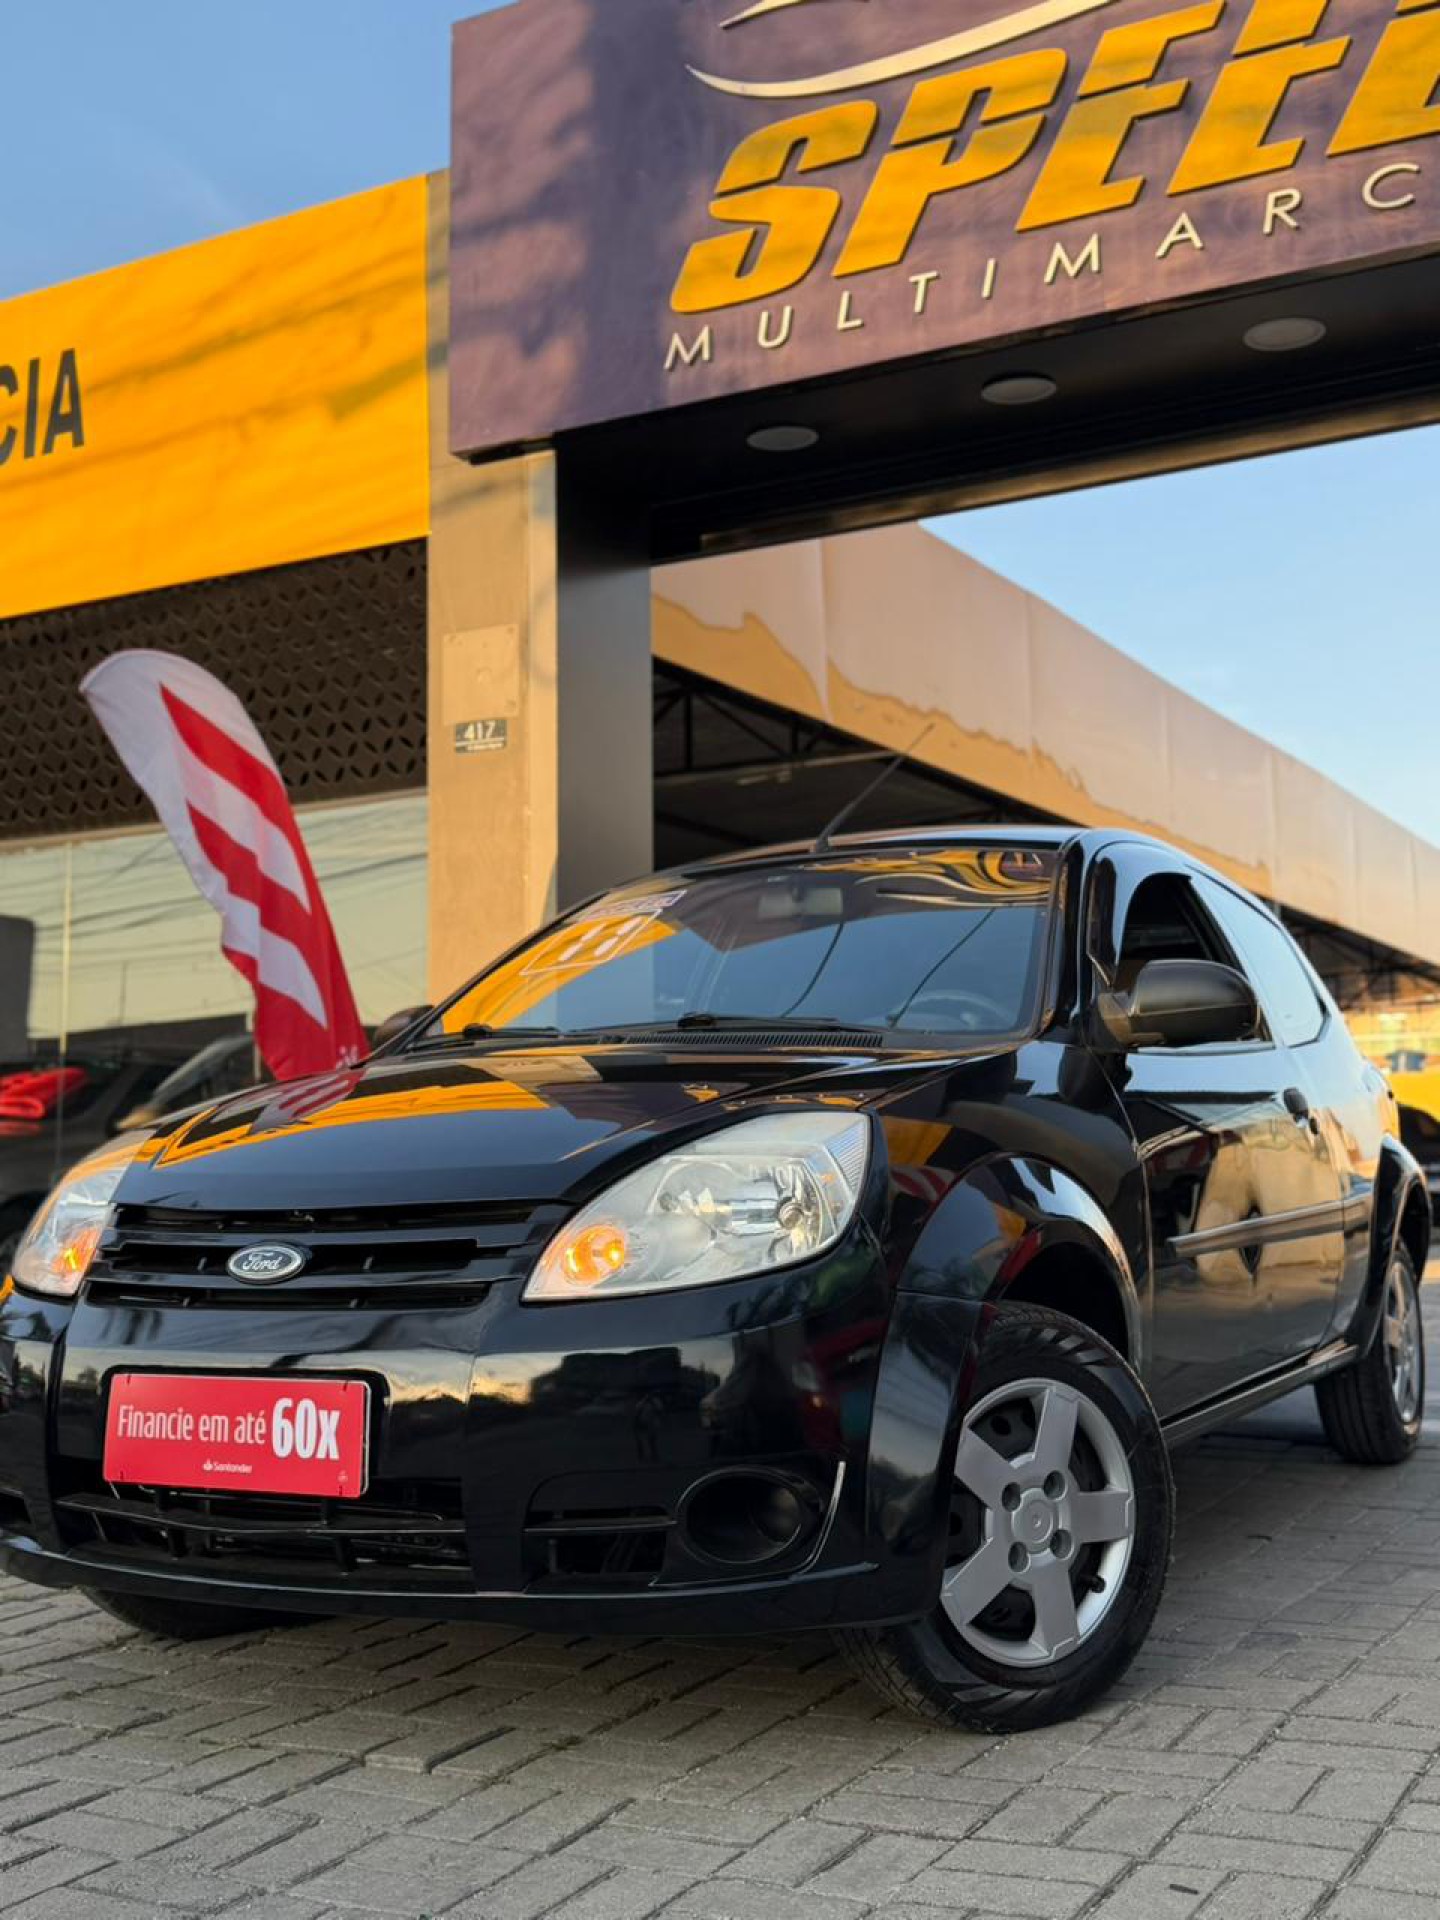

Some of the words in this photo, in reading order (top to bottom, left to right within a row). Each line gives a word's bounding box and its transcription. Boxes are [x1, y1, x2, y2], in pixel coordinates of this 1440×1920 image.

[663, 162, 1421, 371] MULTIMARC
[464, 719, 496, 743] 417
[242, 1251, 283, 1270] Ford
[117, 1404, 193, 1441] Financie
[198, 1414, 229, 1443] em
[233, 1409, 267, 1445] até
[271, 1397, 341, 1461] 60x
[213, 1461, 253, 1474] Santander
